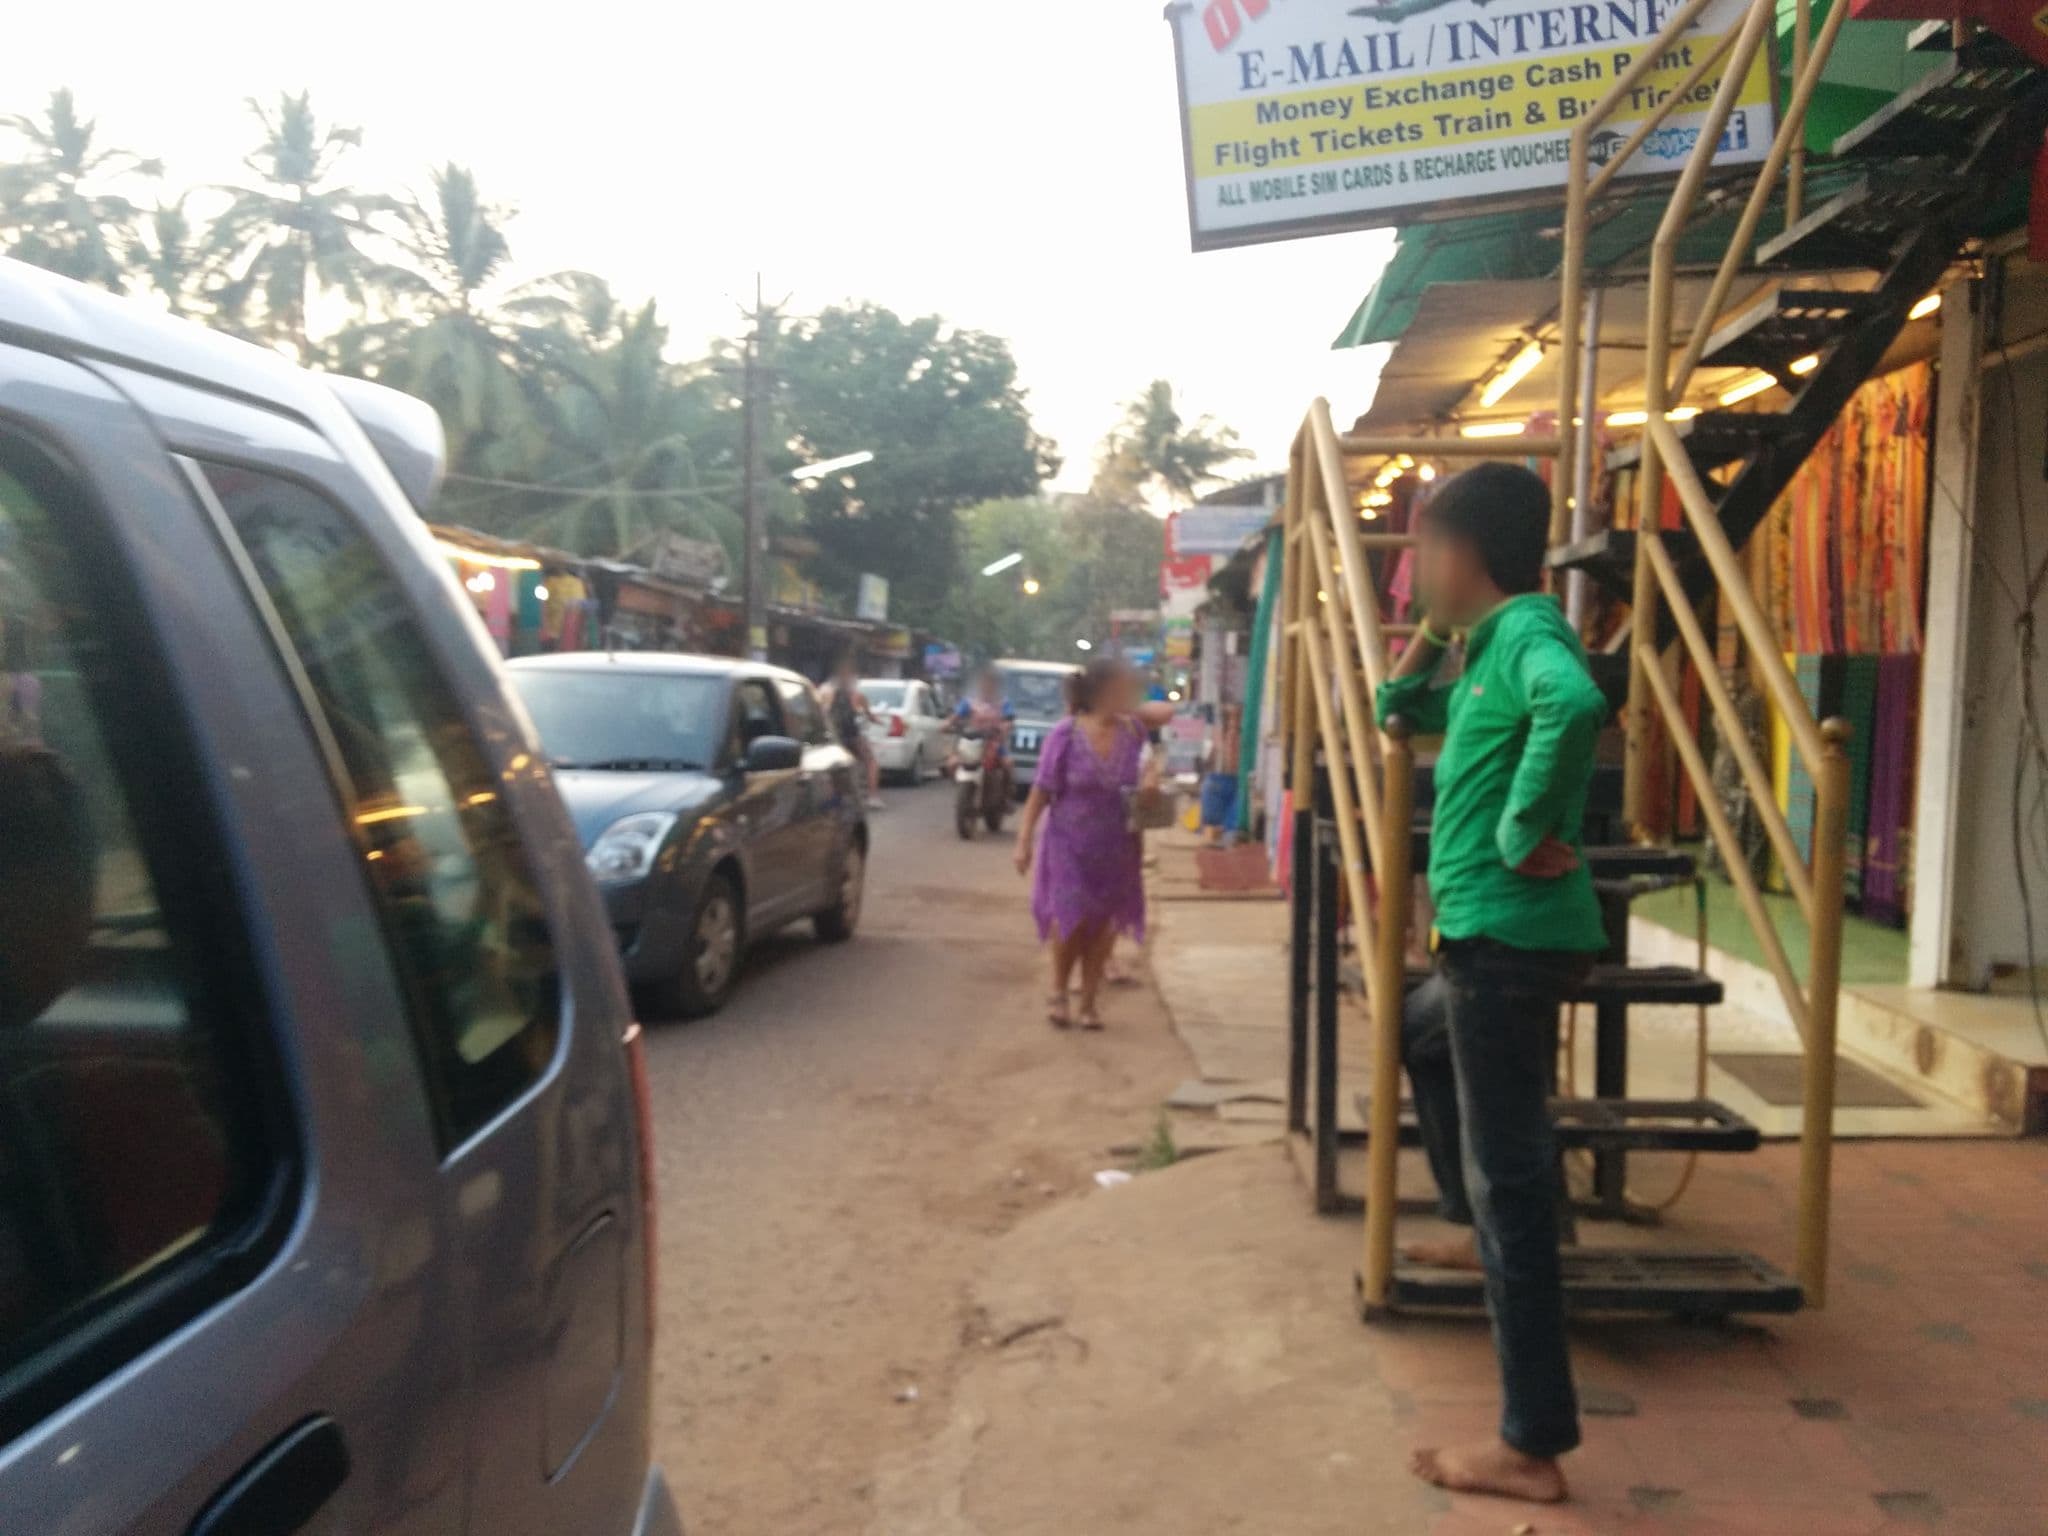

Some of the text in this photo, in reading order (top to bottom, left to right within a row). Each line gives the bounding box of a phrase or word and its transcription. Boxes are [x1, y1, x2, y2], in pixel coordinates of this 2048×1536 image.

[1446, 0, 1699, 62] INTERNE
[1256, 45, 1693, 124] Money Exchange Cash Pnt
[1215, 136, 1300, 167] Flight
[1310, 121, 1423, 153] Tickets
[1434, 108, 1512, 137] Train
[1525, 101, 1546, 124] &
[1218, 183, 1246, 206] ALL
[1250, 174, 1306, 202] MOBILE
[1311, 168, 1338, 195] SIM
[1342, 163, 1393, 191] CARDS
[1398, 160, 1409, 183] &
[1414, 149, 1496, 181] RECHARGE
